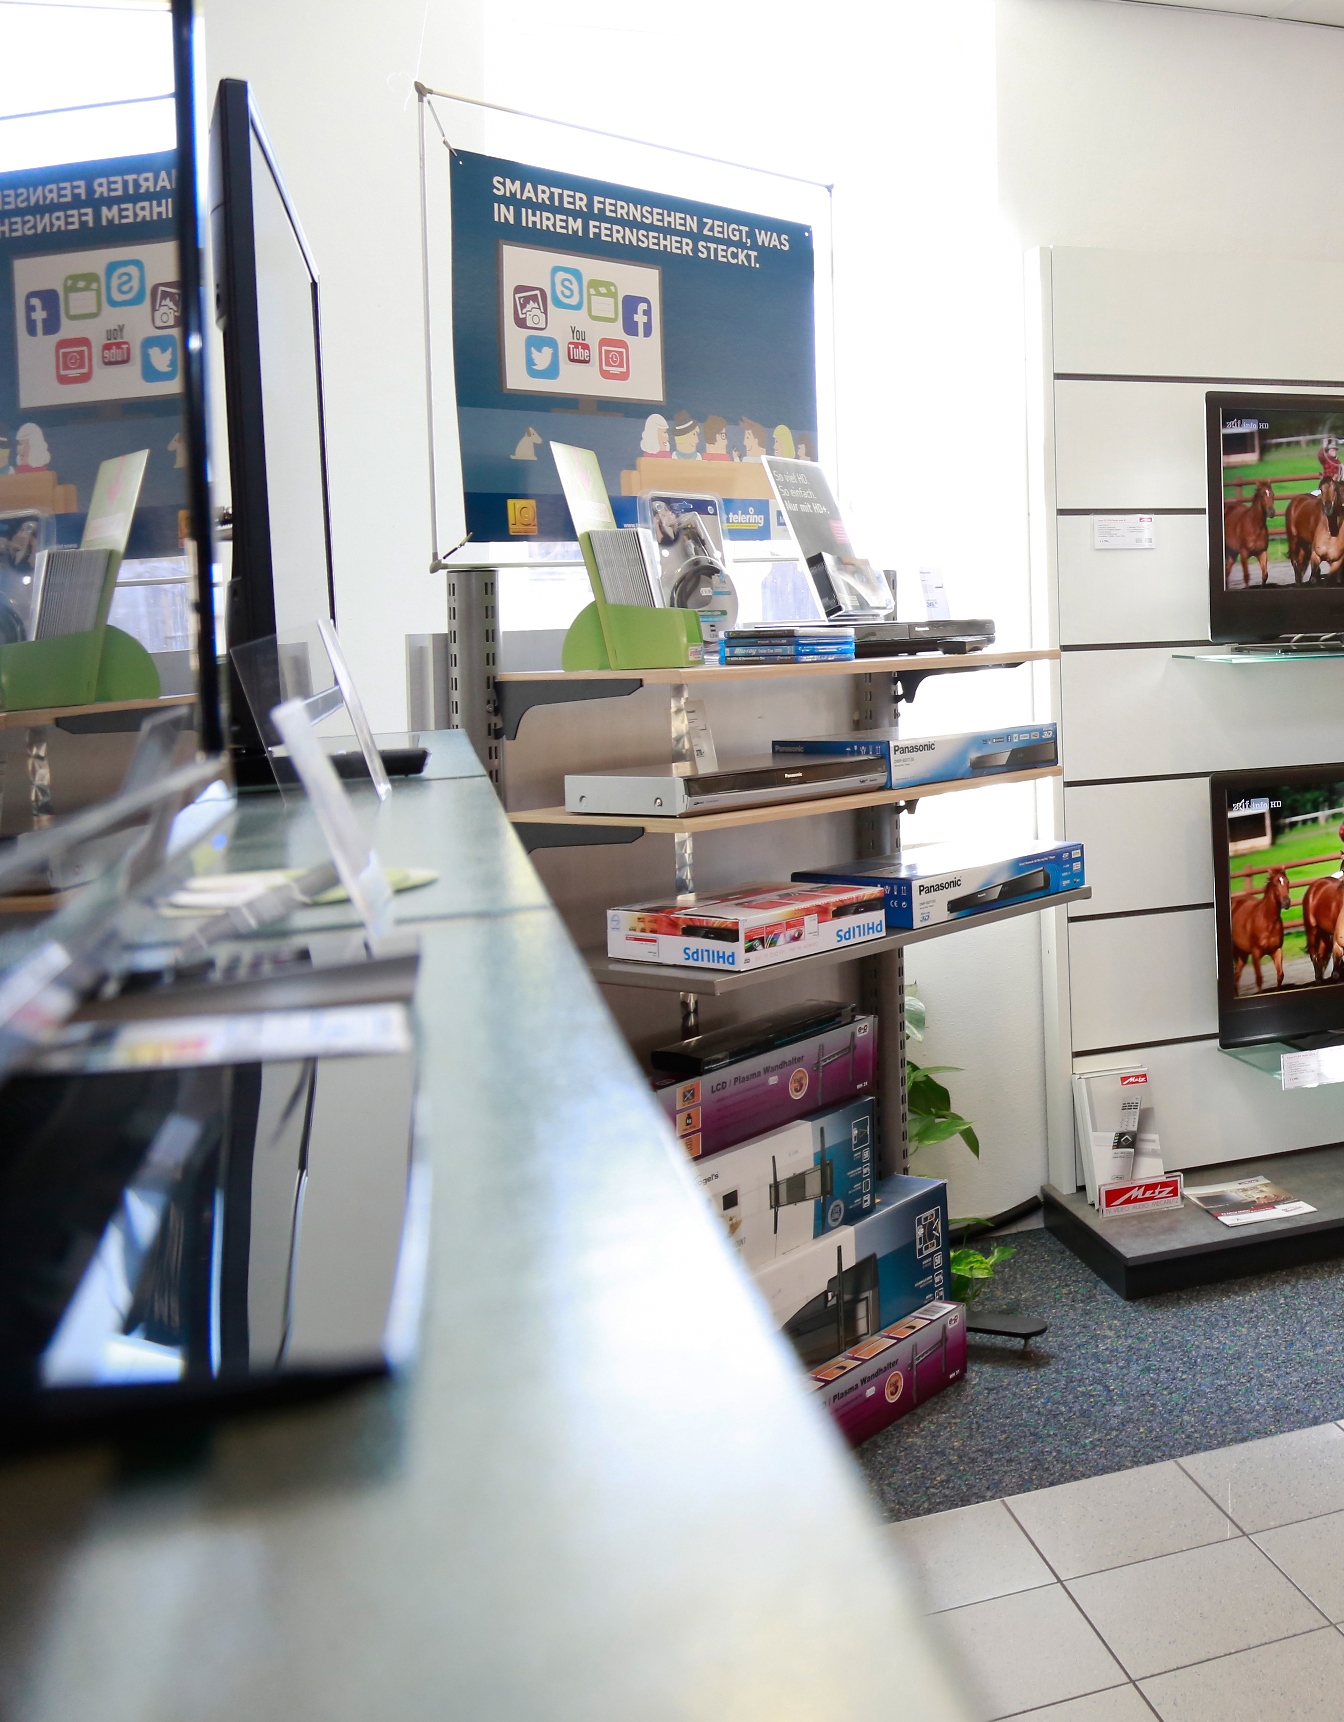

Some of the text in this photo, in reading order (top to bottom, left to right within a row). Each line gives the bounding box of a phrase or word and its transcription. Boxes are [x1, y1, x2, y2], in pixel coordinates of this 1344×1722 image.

[492, 175, 790, 251] SMARTER FERNSEHEN ZEIGT, WAS
[493, 203, 761, 269] IN IHREM FERNSEHER STECKT.
[569, 325, 586, 342] You
[568, 344, 590, 361] Tube
[772, 470, 811, 485] So viel HD.
[778, 485, 790, 497] So
[784, 500, 799, 512] Nur
[800, 502, 813, 513] mit
[728, 507, 765, 527] telering
[893, 742, 936, 755] Panasonic
[918, 877, 962, 896] Panasonic
[836, 919, 883, 943] PHILIPS
[683, 947, 736, 966] PHILIPS
[711, 1083, 727, 1094] LCD
[733, 1071, 762, 1086] Plasma
[763, 1054, 805, 1075] Wandhalter
[1122, 1076, 1147, 1085] Metz
[1110, 1184, 1174, 1207] Metz
[832, 1383, 859, 1403] Plasma
[860, 1358, 900, 1386] Wandhalter
